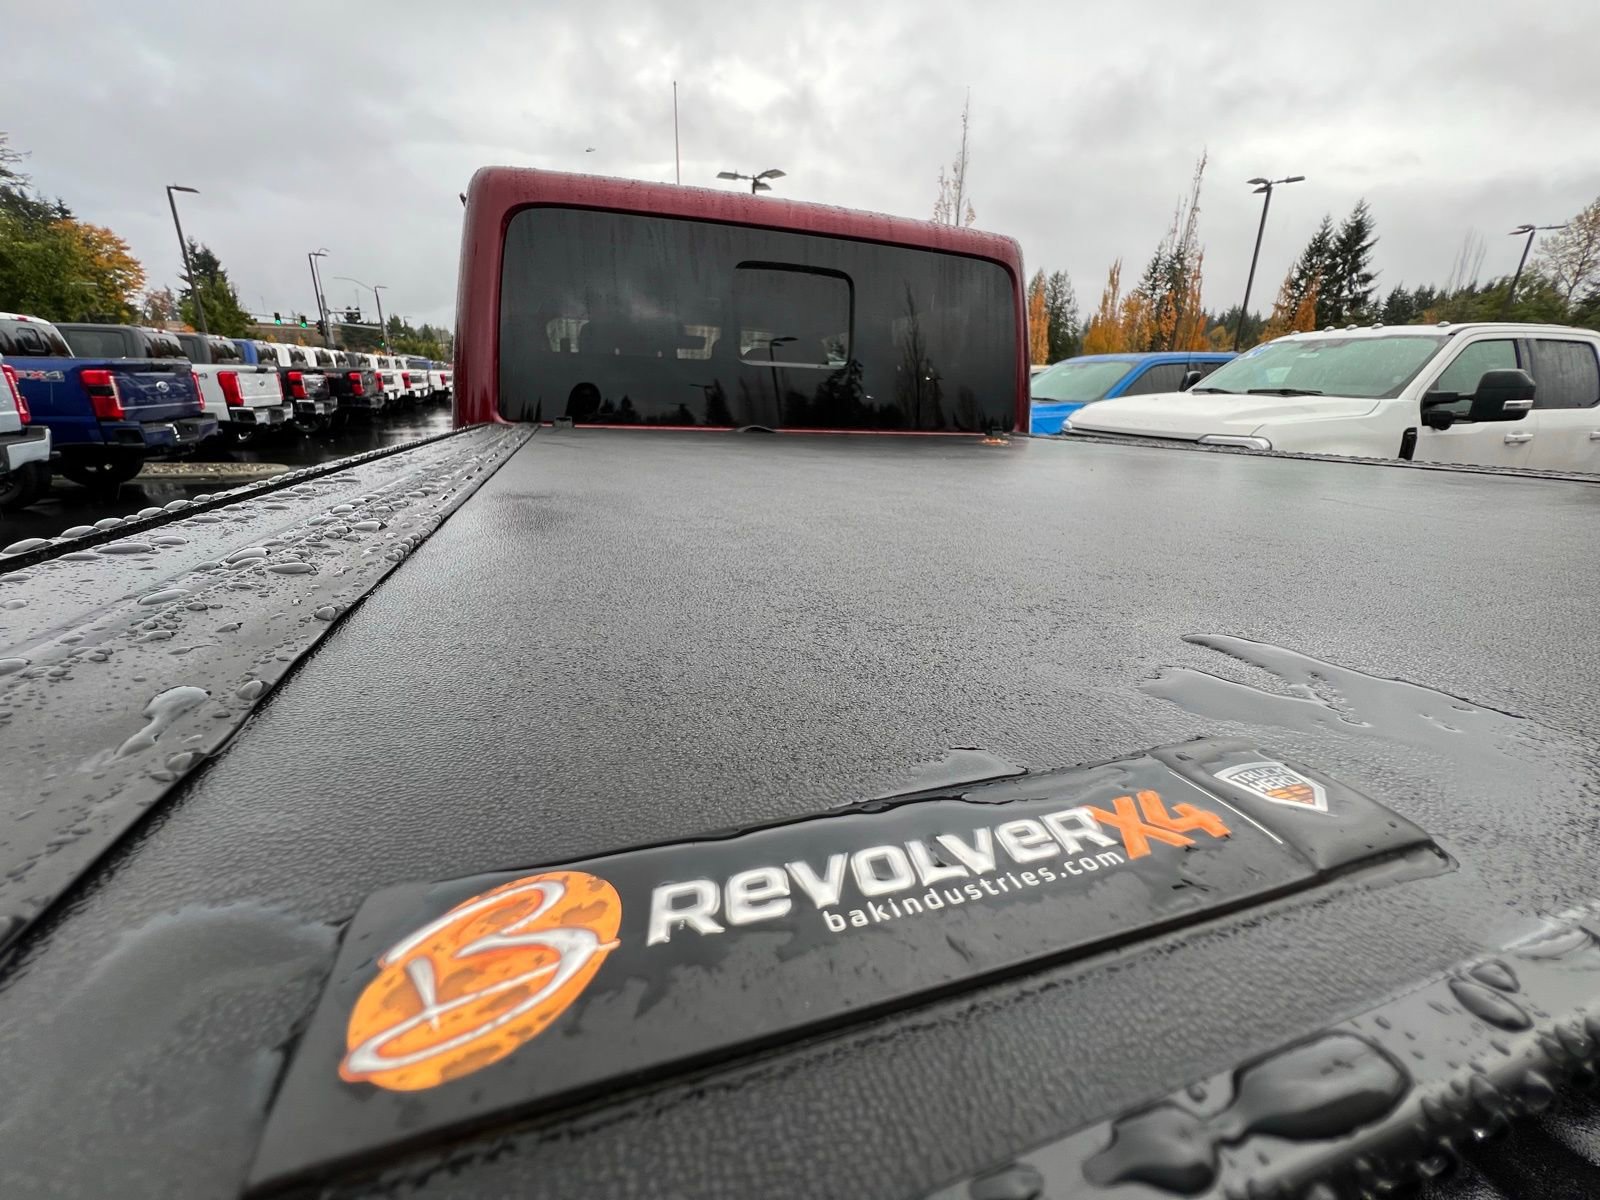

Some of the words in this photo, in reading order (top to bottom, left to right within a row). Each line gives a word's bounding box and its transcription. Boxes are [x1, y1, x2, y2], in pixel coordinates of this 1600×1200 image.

[1230, 766, 1292, 783] TRUCK
[1248, 774, 1303, 793] HERO
[823, 848, 1125, 933] bakindustries.com
